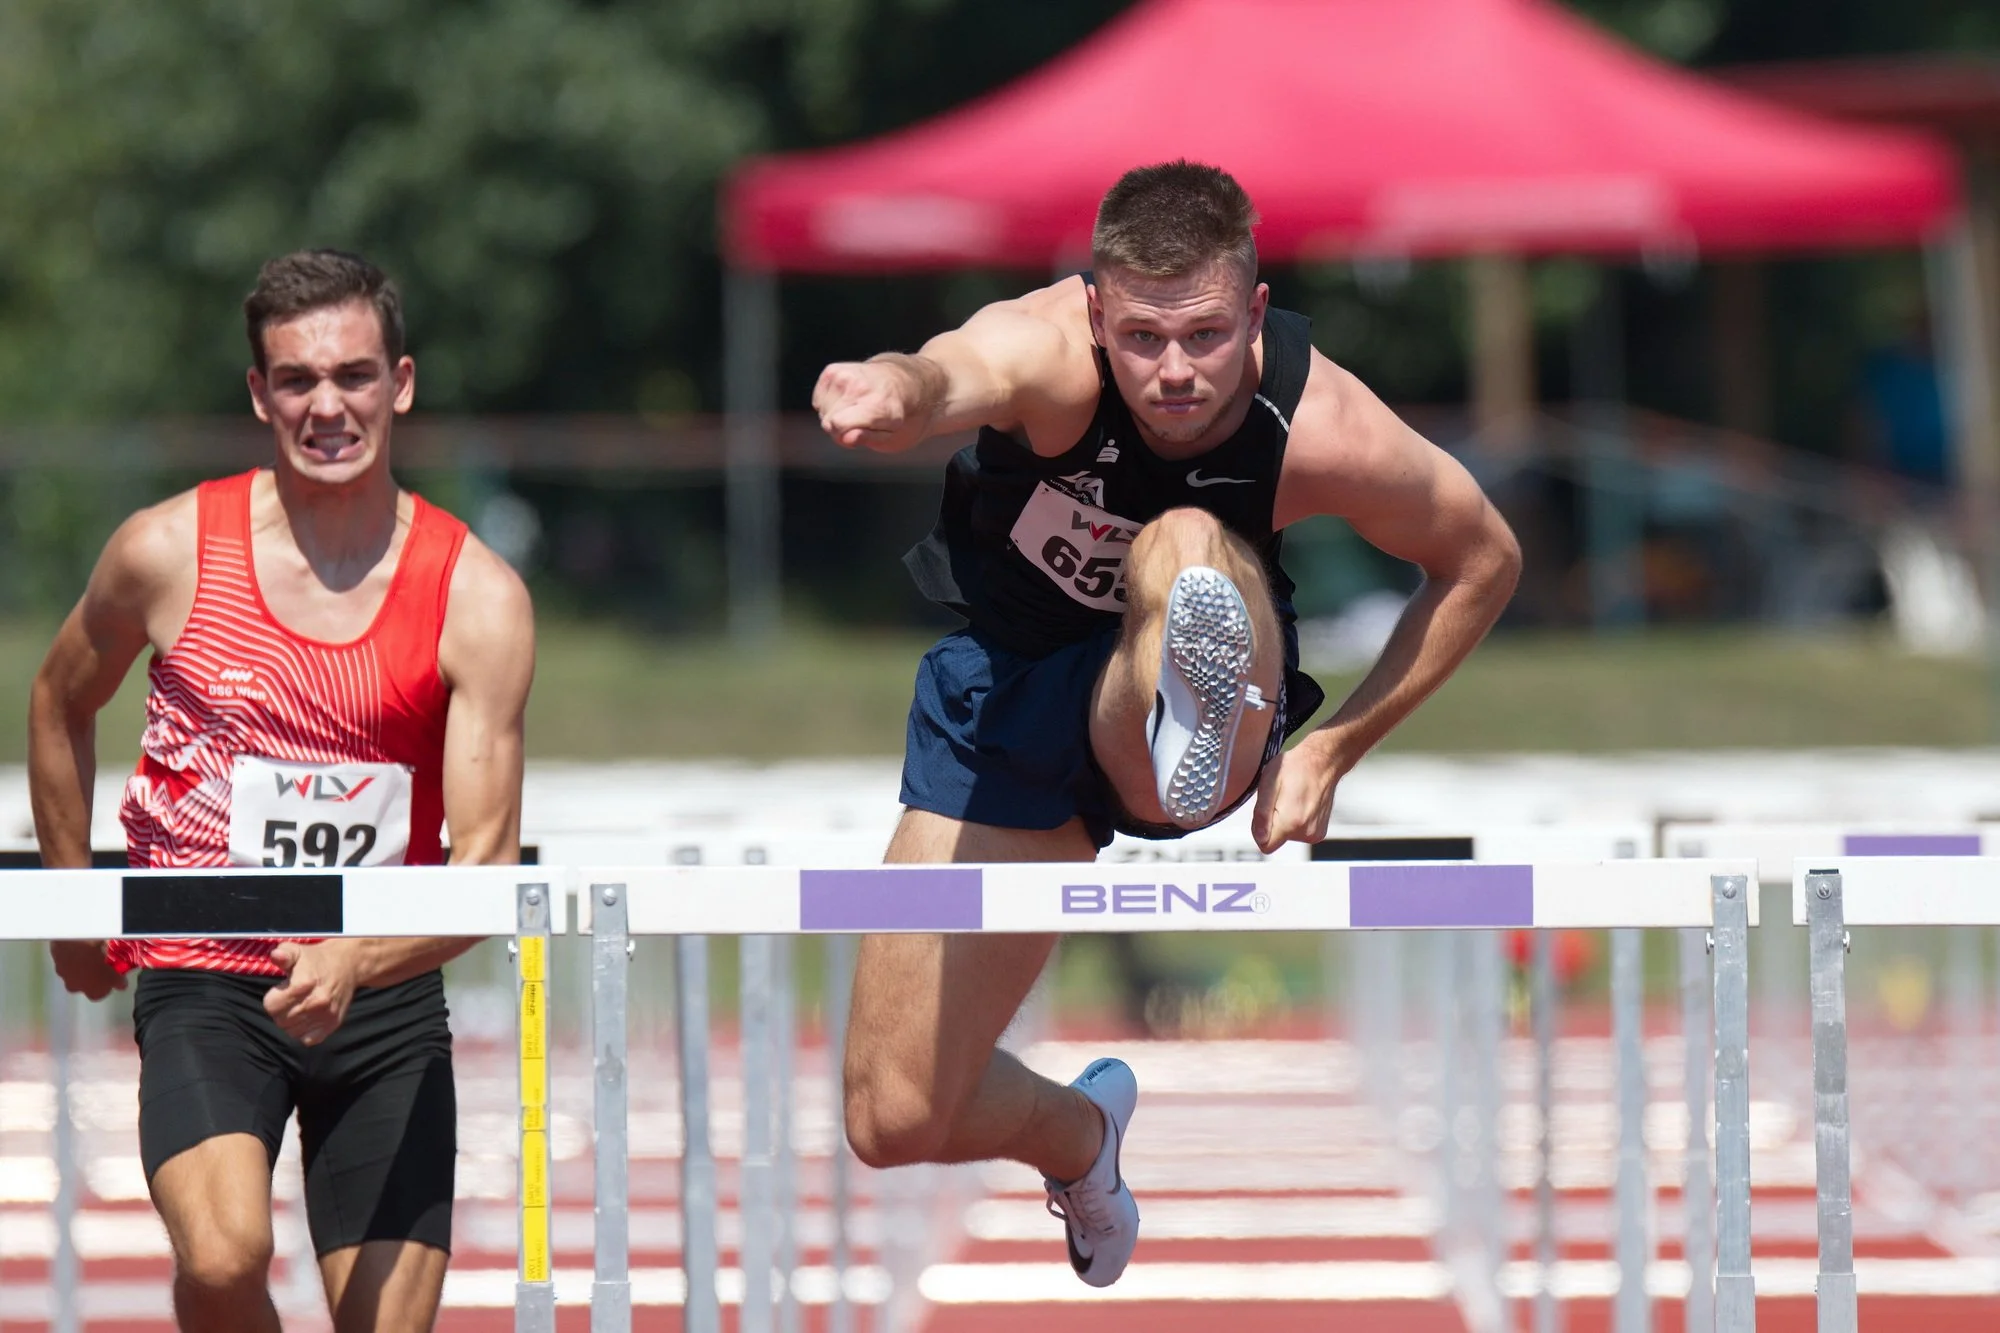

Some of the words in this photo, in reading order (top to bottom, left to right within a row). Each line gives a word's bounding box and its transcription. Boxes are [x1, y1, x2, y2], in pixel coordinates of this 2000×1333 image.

[208, 683, 233, 696] DSG
[234, 684, 267, 701] Wien
[262, 819, 377, 868] 592
